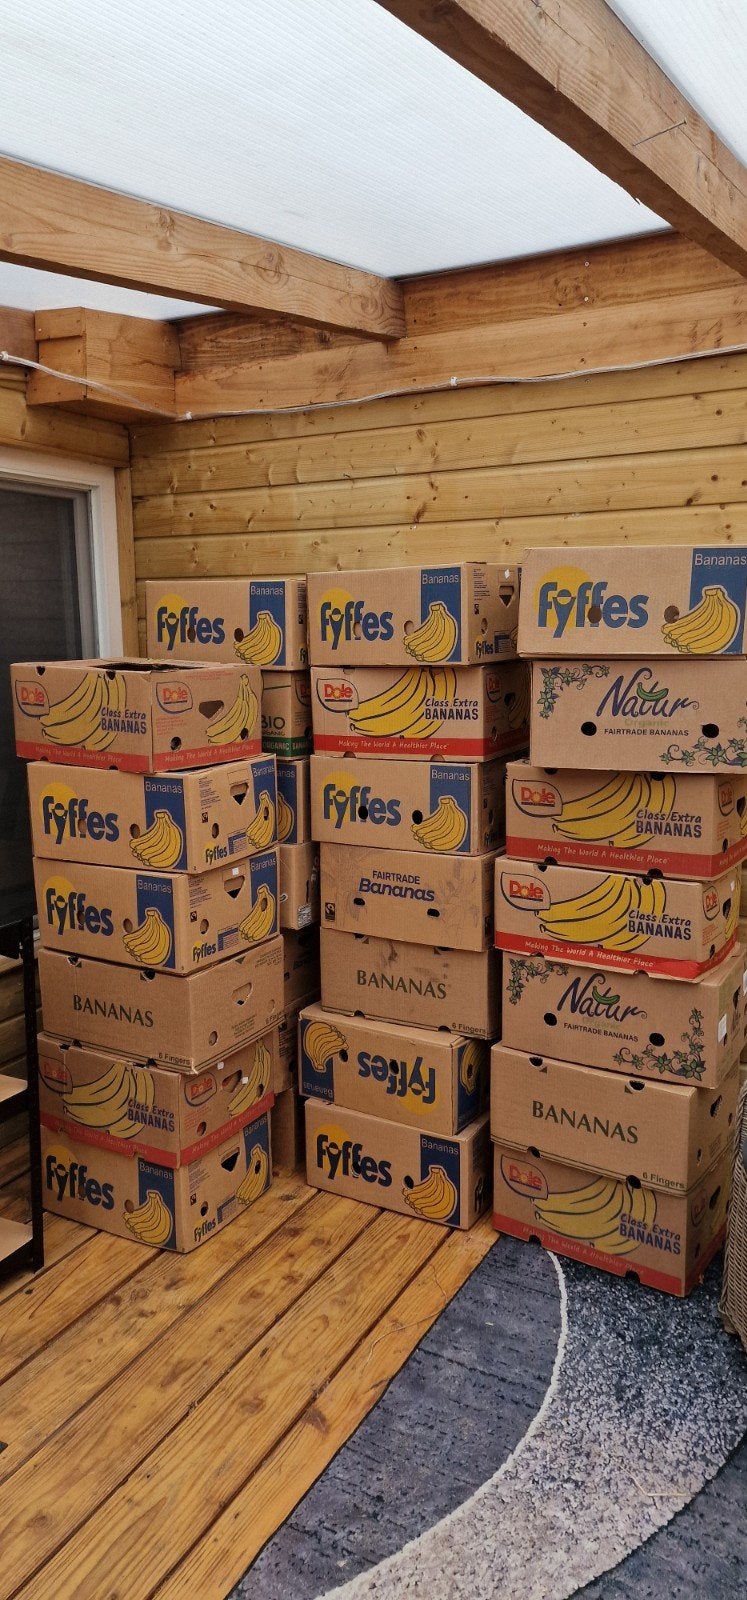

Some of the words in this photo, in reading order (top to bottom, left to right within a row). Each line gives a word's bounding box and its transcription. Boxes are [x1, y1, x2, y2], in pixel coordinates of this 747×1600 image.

[695, 553, 747, 566] Bananas
[422, 574, 459, 585] Bananas
[250, 586, 283, 596] Bananas
[20, 687, 44, 703] Dole
[163, 687, 188, 703] Dole
[324, 684, 353, 698] Dole
[596, 667, 699, 717] Natur
[425, 698, 449, 707] Class
[453, 699, 478, 707] Extra
[101, 708, 122, 718] Class
[125, 710, 145, 719] Extra
[425, 710, 478, 720] BANANAS
[101, 719, 147, 734] BANANAS
[339, 740, 358, 748] Making
[430, 742, 447, 750] Place
[165, 753, 184, 763] Making
[186, 752, 195, 760] The
[197, 750, 212, 759] World
[253, 763, 275, 777] Bananas
[432, 770, 469, 780] Bananas
[145, 782, 182, 793] Bananas
[521, 787, 555, 803] Dole
[636, 809, 665, 821] Class
[670, 812, 701, 823] Extra
[636, 821, 701, 838] BANANAS
[537, 845, 561, 855] Making
[563, 847, 576, 855] The
[579, 849, 598, 857] World
[610, 852, 644, 862] Healthier
[646, 855, 667, 863] Place
[251, 859, 277, 872] Bananas
[373, 871, 420, 884] FAIRTRADE
[138, 879, 172, 893] Bananas
[359, 878, 434, 901] Bananas
[510, 880, 543, 898] Dole
[629, 910, 656, 921] Class
[663, 914, 691, 926] Extra
[629, 920, 691, 940] BANANAS
[525, 941, 548, 952] Making
[552, 944, 564, 953] The
[567, 948, 586, 957] World
[634, 958, 654, 967] Place
[357, 970, 446, 999] BANANAS
[557, 973, 647, 1022] Natur
[74, 995, 154, 1028] BANANAS
[458, 1023, 486, 1034] Fingers
[564, 1022, 601, 1035] FAIRTRADE
[604, 1029, 639, 1042] BANANAS
[165, 1053, 190, 1065] Fingers
[190, 1077, 213, 1096] Dole
[128, 1100, 149, 1112] Class
[152, 1106, 174, 1118] Extra
[128, 1109, 174, 1132] BANANAS
[532, 1101, 638, 1143] BANANAS
[422, 1138, 458, 1155] Bananas
[139, 1163, 173, 1180] Bananas
[509, 1165, 542, 1186] Dole
[650, 1173, 685, 1189] Fingers
[620, 1214, 648, 1228] Class
[653, 1225, 680, 1240] Extra
[620, 1223, 680, 1254] BANANAS
